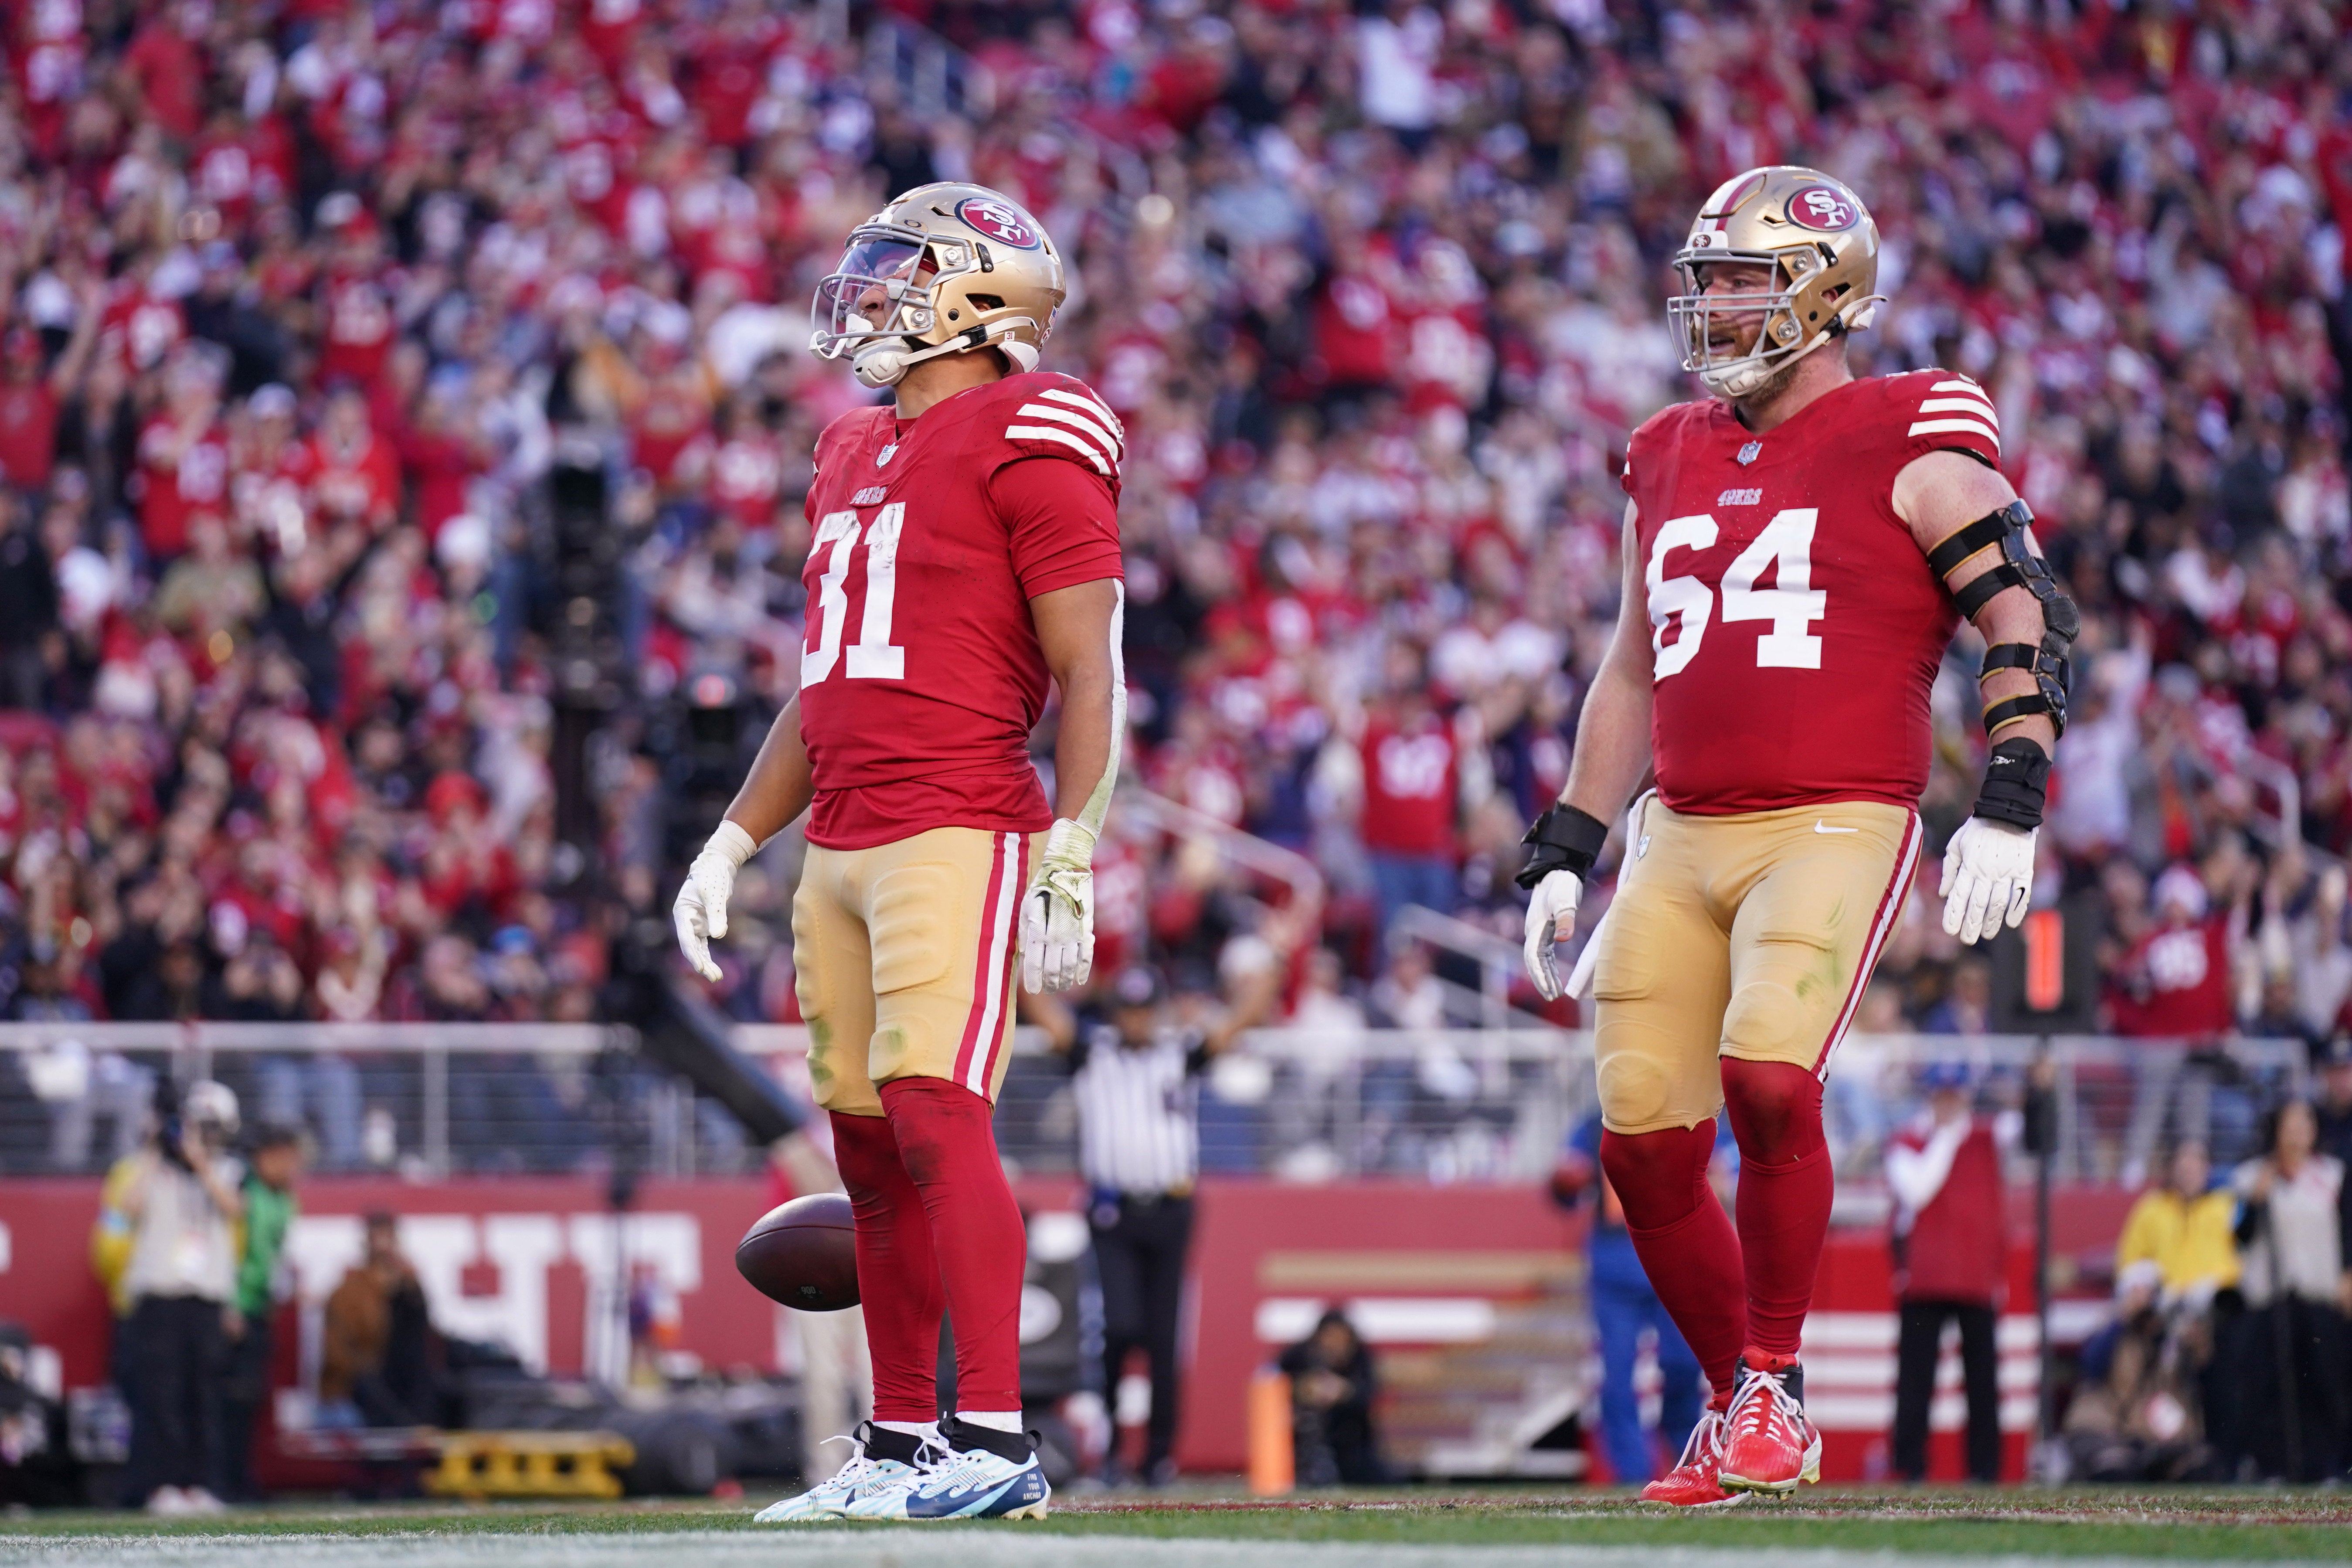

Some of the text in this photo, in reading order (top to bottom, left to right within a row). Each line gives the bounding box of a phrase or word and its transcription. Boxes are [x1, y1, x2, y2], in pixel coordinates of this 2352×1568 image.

[982, 203, 1030, 241] SF
[1804, 190, 1850, 227] SF
[1717, 488, 1763, 507] 49ERS
[801, 502, 906, 690] 31
[1646, 507, 1827, 682] 64
[1023, 1491, 1041, 1500] ANCHOR
